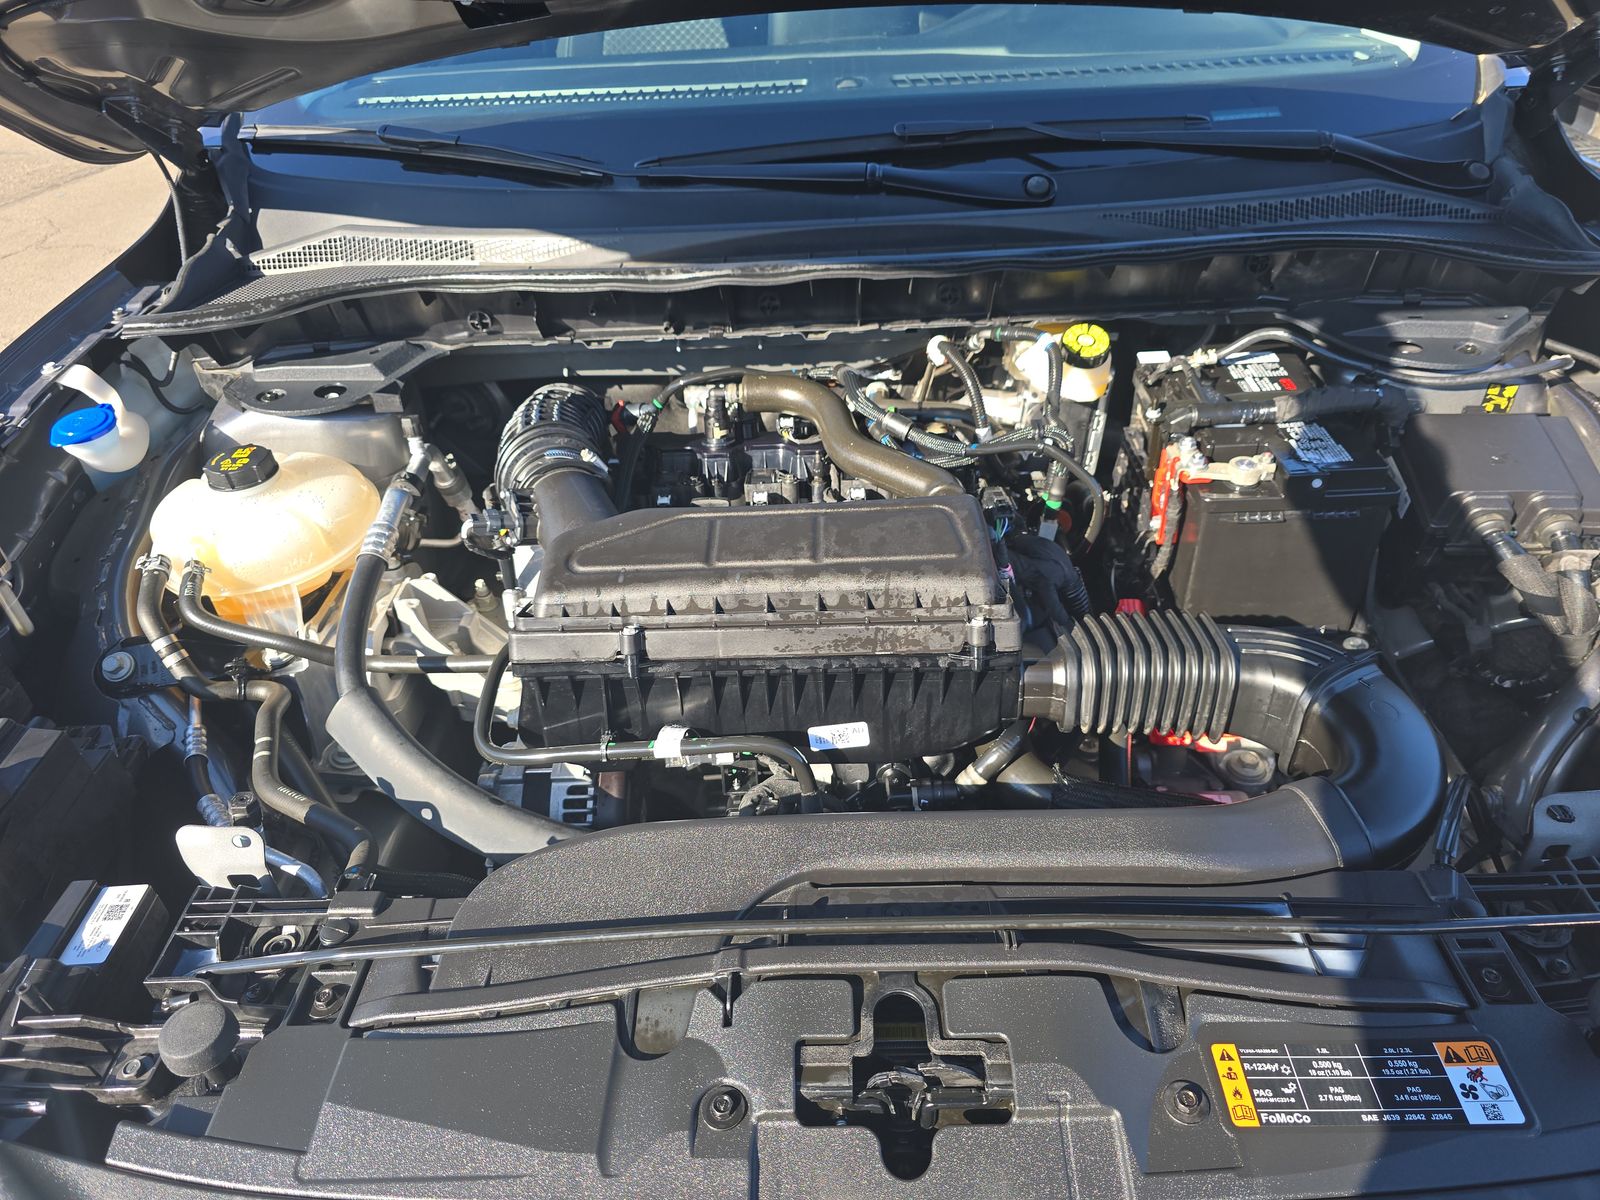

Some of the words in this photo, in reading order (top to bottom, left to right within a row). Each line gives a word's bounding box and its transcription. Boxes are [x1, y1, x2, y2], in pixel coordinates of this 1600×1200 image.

[1243, 1062, 1279, 1072] R-1234yf
[1311, 1060, 1331, 1068] 0.500
[1331, 1060, 1343, 1070] kg
[1387, 1059, 1407, 1067] 0.550
[1408, 1059, 1418, 1069] kg
[1325, 1069, 1340, 1077] (1.10
[1340, 1069, 1353, 1077] lbs)
[1252, 1089, 1273, 1097] PAG
[1329, 1086, 1345, 1094] PAG
[1419, 1094, 1441, 1102] (100cc)
[1260, 1112, 1311, 1123] FoMoCo
[1404, 1113, 1426, 1121] J2842
